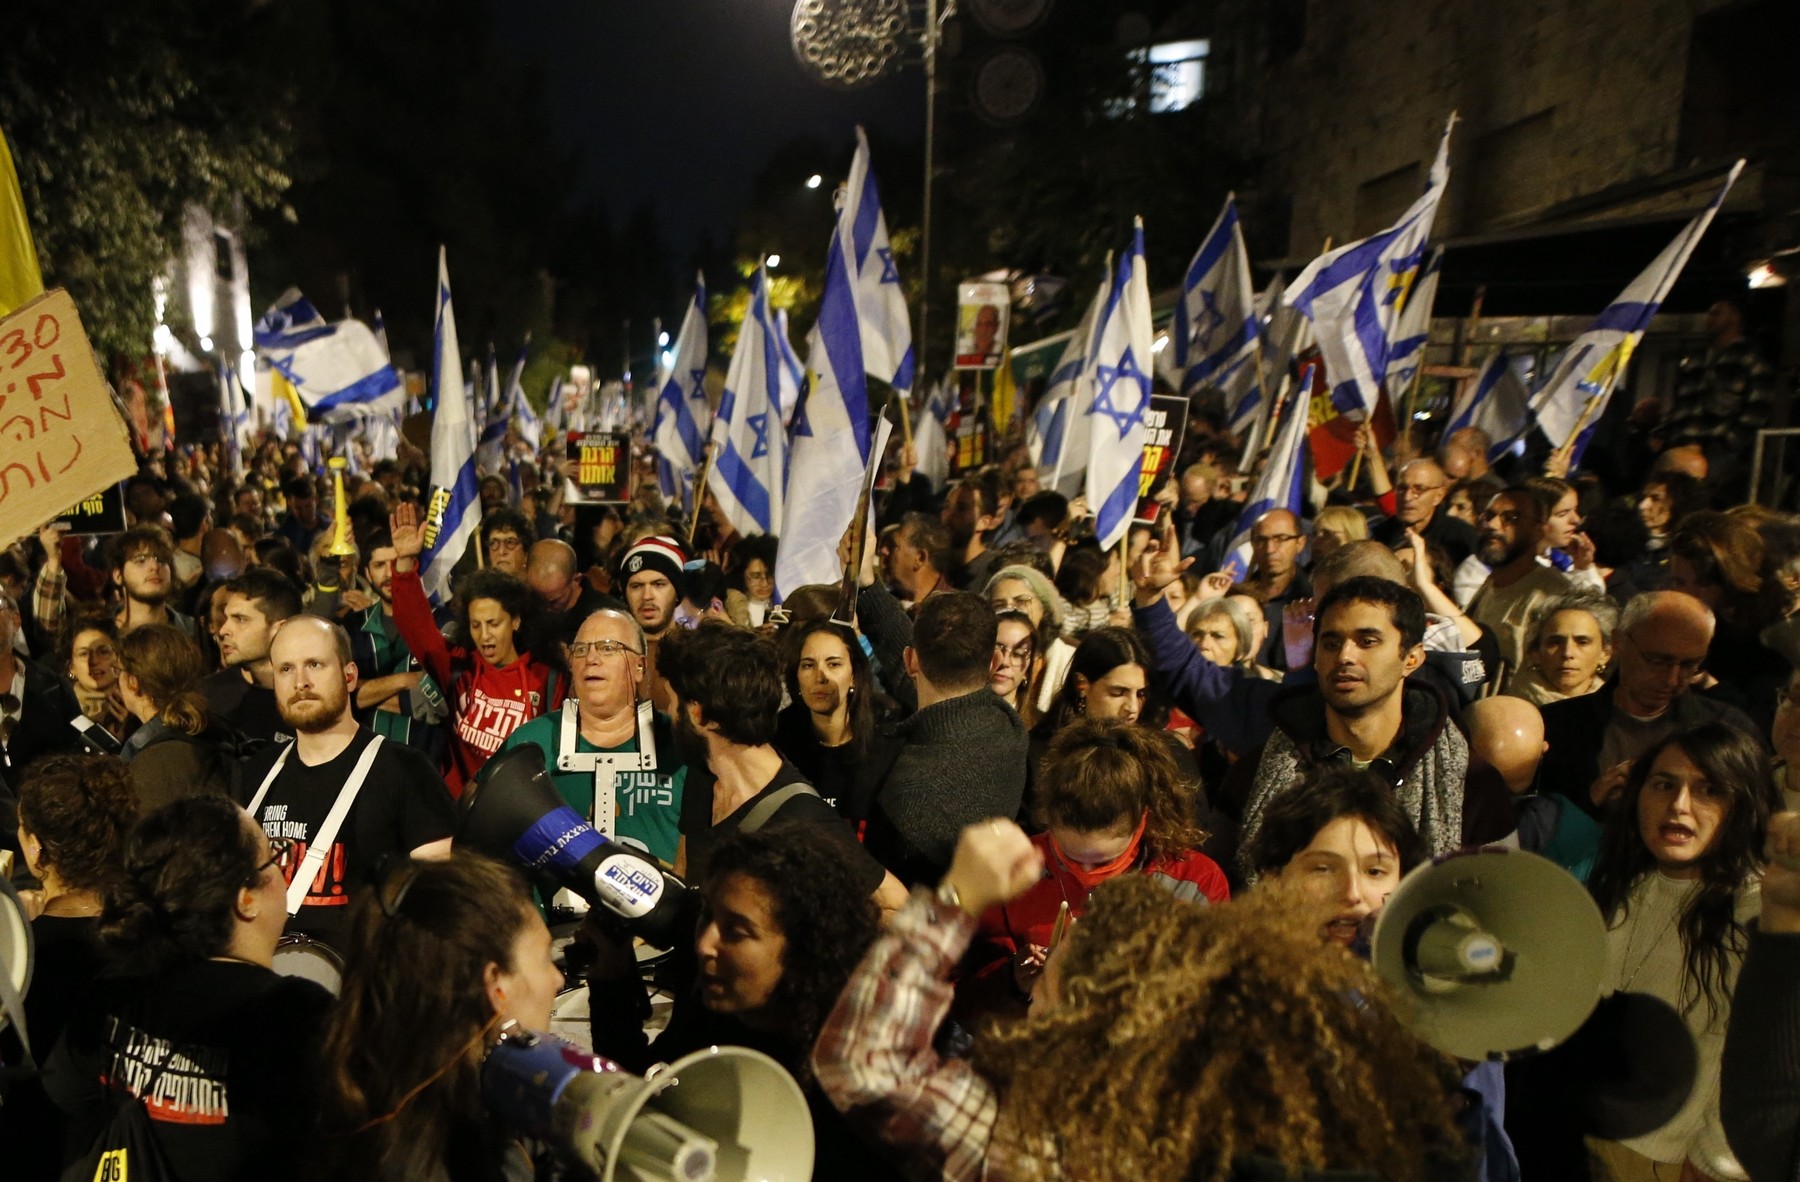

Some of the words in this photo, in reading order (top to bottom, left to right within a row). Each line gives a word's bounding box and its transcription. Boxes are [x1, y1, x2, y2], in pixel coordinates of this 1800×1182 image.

[580, 446, 615, 464] הרגת
[579, 464, 616, 484] אותנו
[628, 789, 673, 816] כיוון
[263, 804, 288, 822] BRING
[262, 820, 281, 838] THEM
[281, 820, 308, 840] HOME
[630, 870, 658, 895] היום
